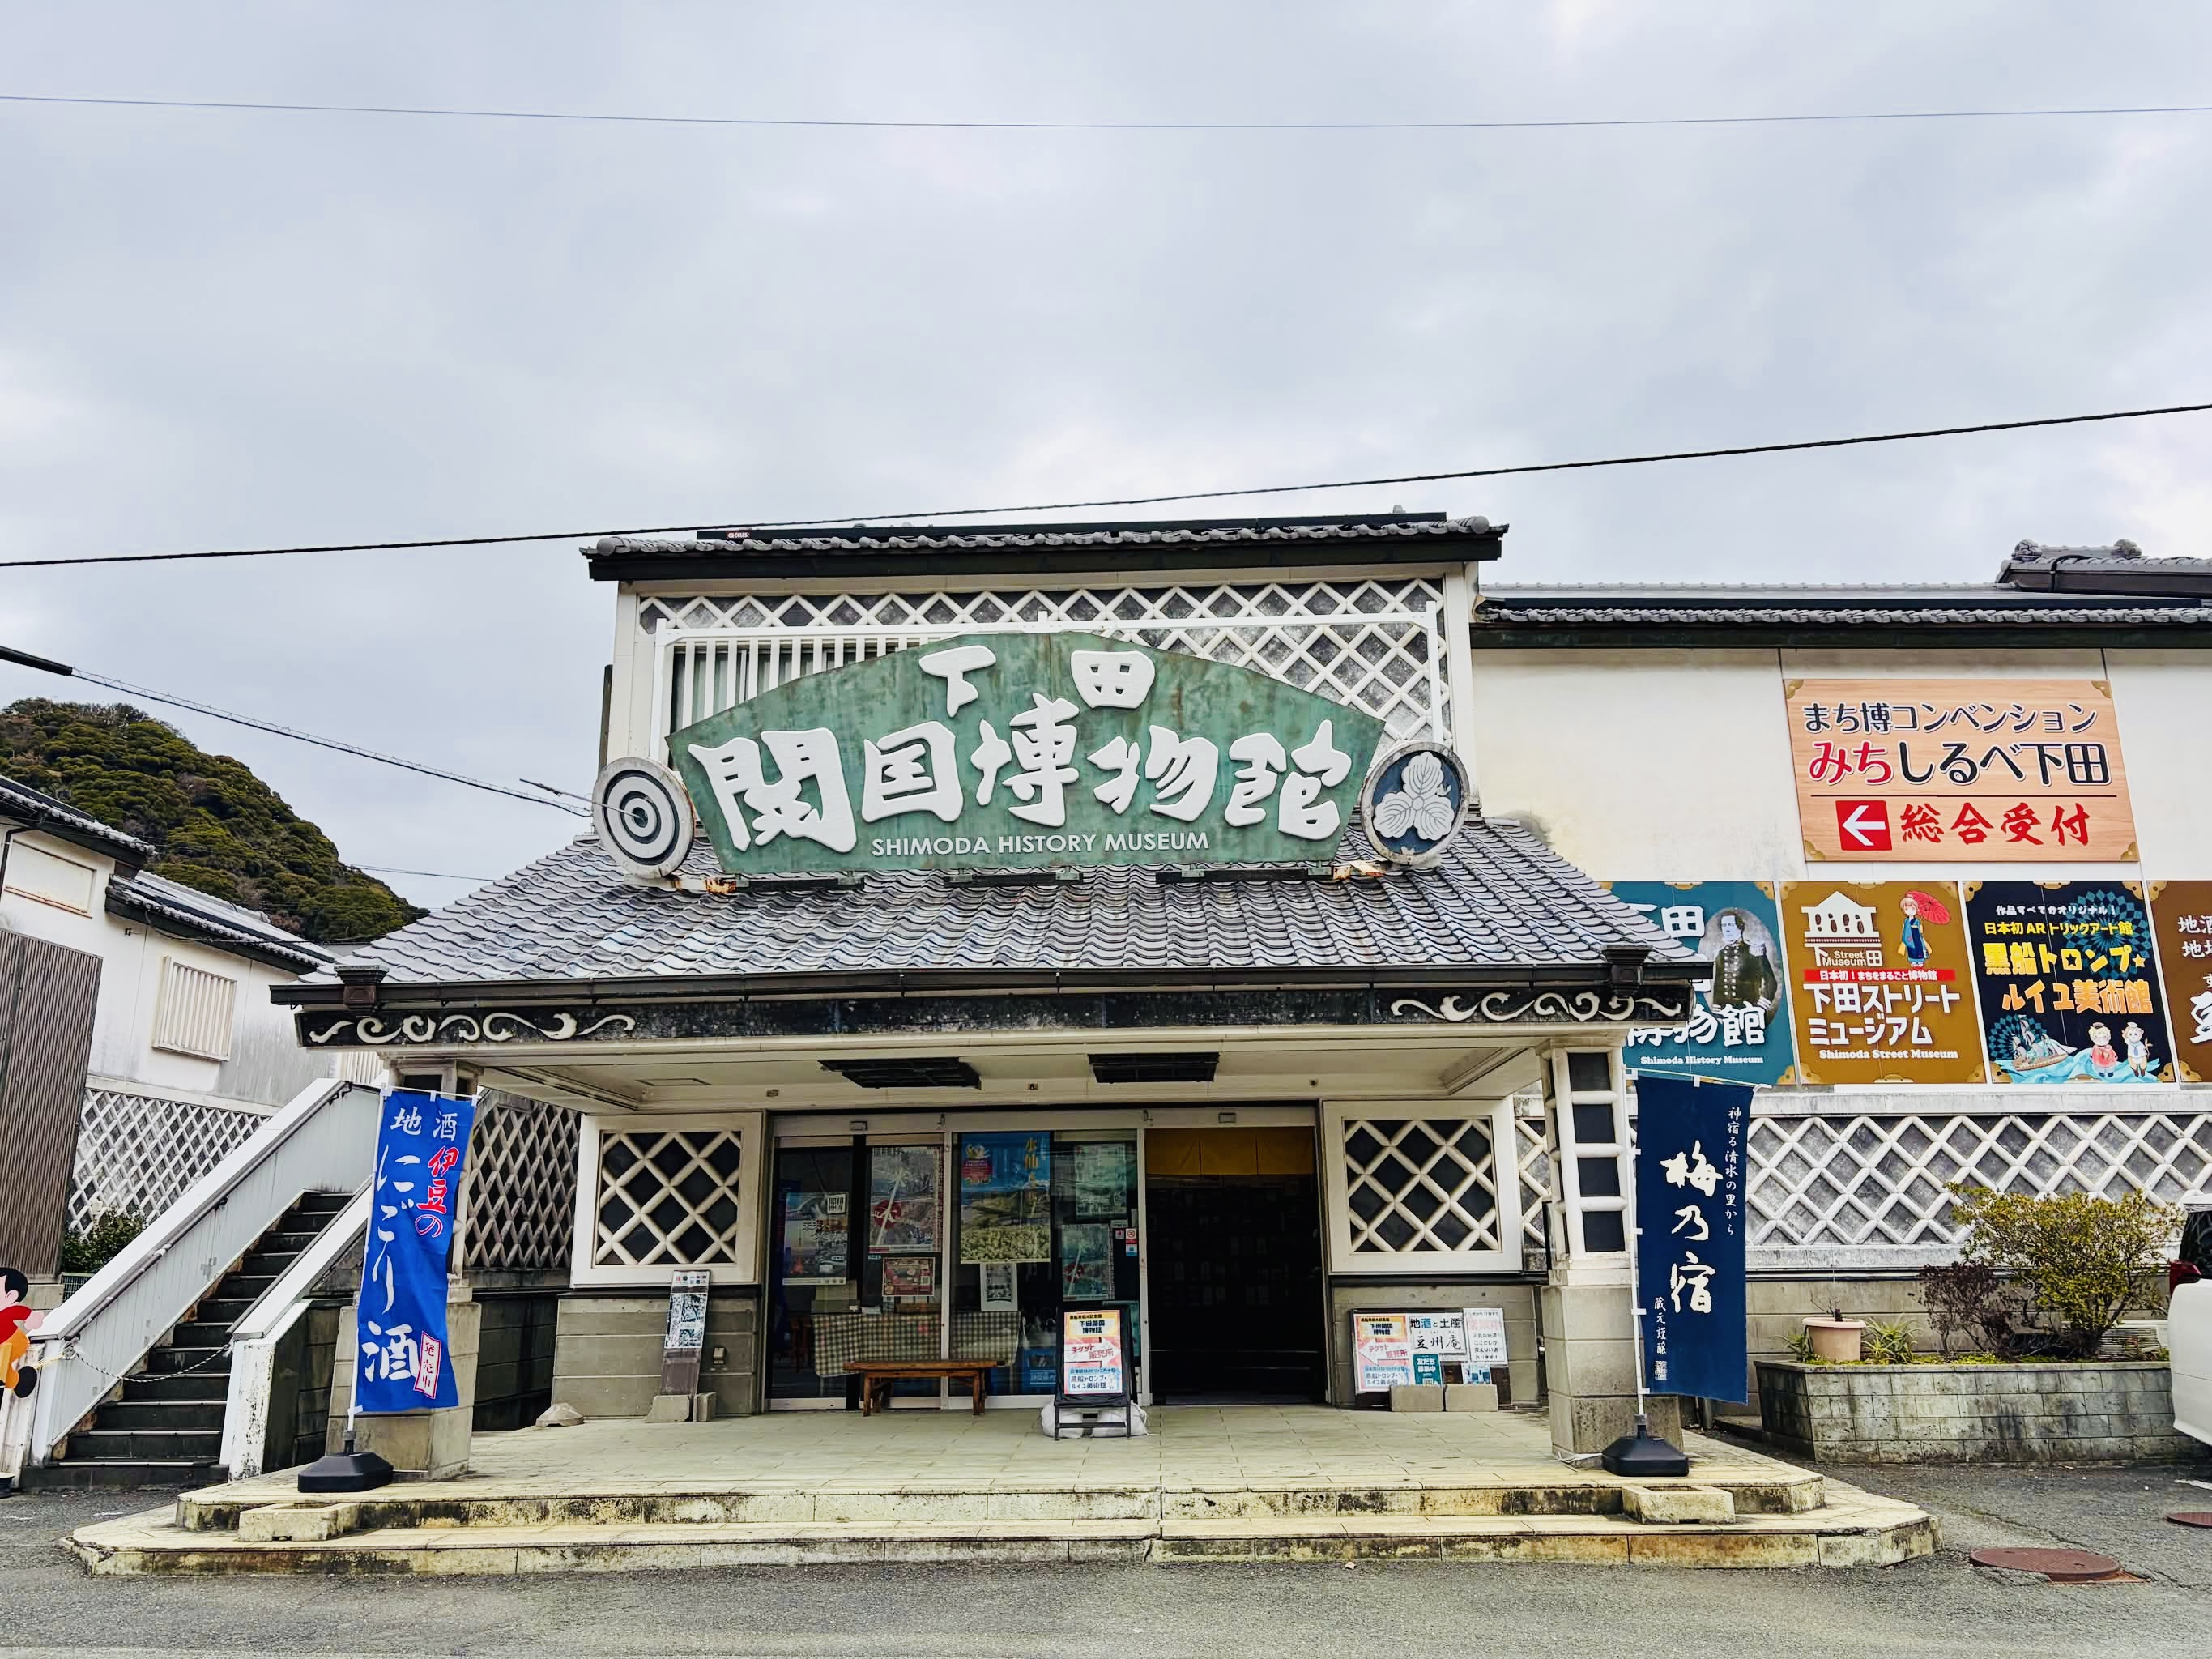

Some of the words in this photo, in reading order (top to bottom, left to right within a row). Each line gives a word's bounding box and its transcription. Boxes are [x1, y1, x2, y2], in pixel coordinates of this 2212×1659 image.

[918, 646, 1154, 717] 下田
[1802, 702, 2097, 734] まち博コンベンション
[688, 693, 1352, 853] 開国博物館
[1809, 740, 2112, 787] みちしるべ下田
[1901, 801, 2091, 847] 総合受付
[872, 837, 991, 856] SHIMODA
[999, 834, 1097, 853] HISTORY
[1104, 832, 1209, 851] MUSEUM
[1822, 957, 1866, 966] Museum
[1834, 950, 1864, 959] Street
[1803, 983, 1961, 1013] 下田ストリート
[2001, 979, 2153, 1014] ルイユ美術館
[1808, 1013, 1933, 1046] ミュージアム
[1640, 1056, 1683, 1065] Shimoda
[1686, 1056, 1722, 1066] History
[1724, 1056, 1764, 1065] Museum
[1819, 1050, 1869, 1059] Shimoda
[1872, 1050, 1909, 1059] Street
[1910, 1050, 1958, 1059] Museum
[390, 1106, 458, 1142] 地酒
[1724, 1107, 1742, 1235] 神宿る清水の里から
[414, 1145, 460, 1238] 伊豆の
[1660, 1140, 1724, 1314] 梅乃宿
[361, 1144, 420, 1382] にごり酒
[1410, 1317, 1462, 1329] 地酒と土産
[1415, 1334, 1461, 1350] 豆州庵
